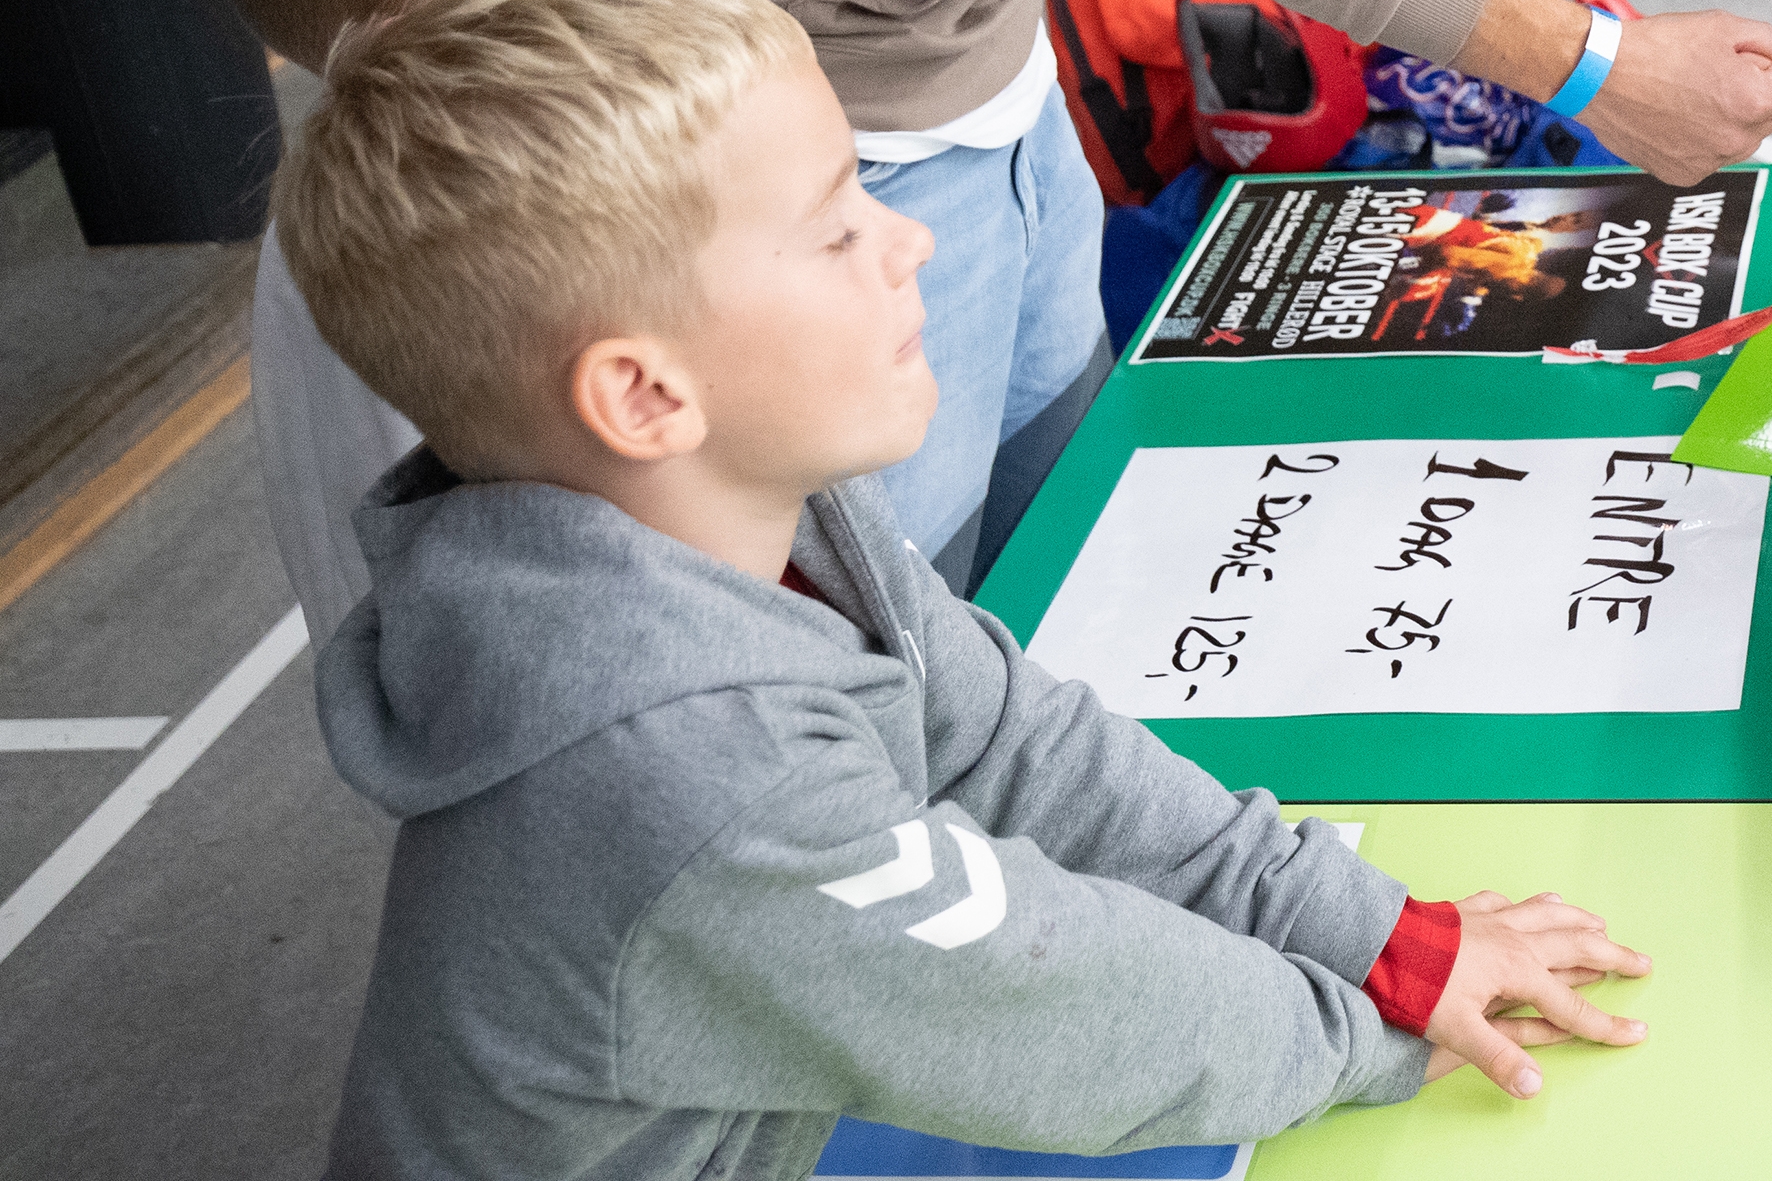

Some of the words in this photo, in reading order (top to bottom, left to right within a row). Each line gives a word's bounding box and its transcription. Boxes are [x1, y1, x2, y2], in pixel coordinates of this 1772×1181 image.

[1327, 196, 1366, 235] ROYAL
[1355, 187, 1426, 234] 13-15
[1666, 191, 1725, 231] HSK
[1308, 235, 1346, 273] STAGE
[1581, 219, 1651, 290] 2023
[1654, 233, 1714, 277] BOX
[1302, 236, 1407, 341] OKTOBER
[1646, 277, 1704, 328] CUP
[1271, 280, 1325, 348] HILLERØD
[1260, 455, 1339, 479] 2
[1425, 453, 1528, 481] 1
[1210, 495, 1311, 593] DAGE
[1375, 498, 1474, 570] DAG
[1568, 451, 1694, 635] ENTRE
